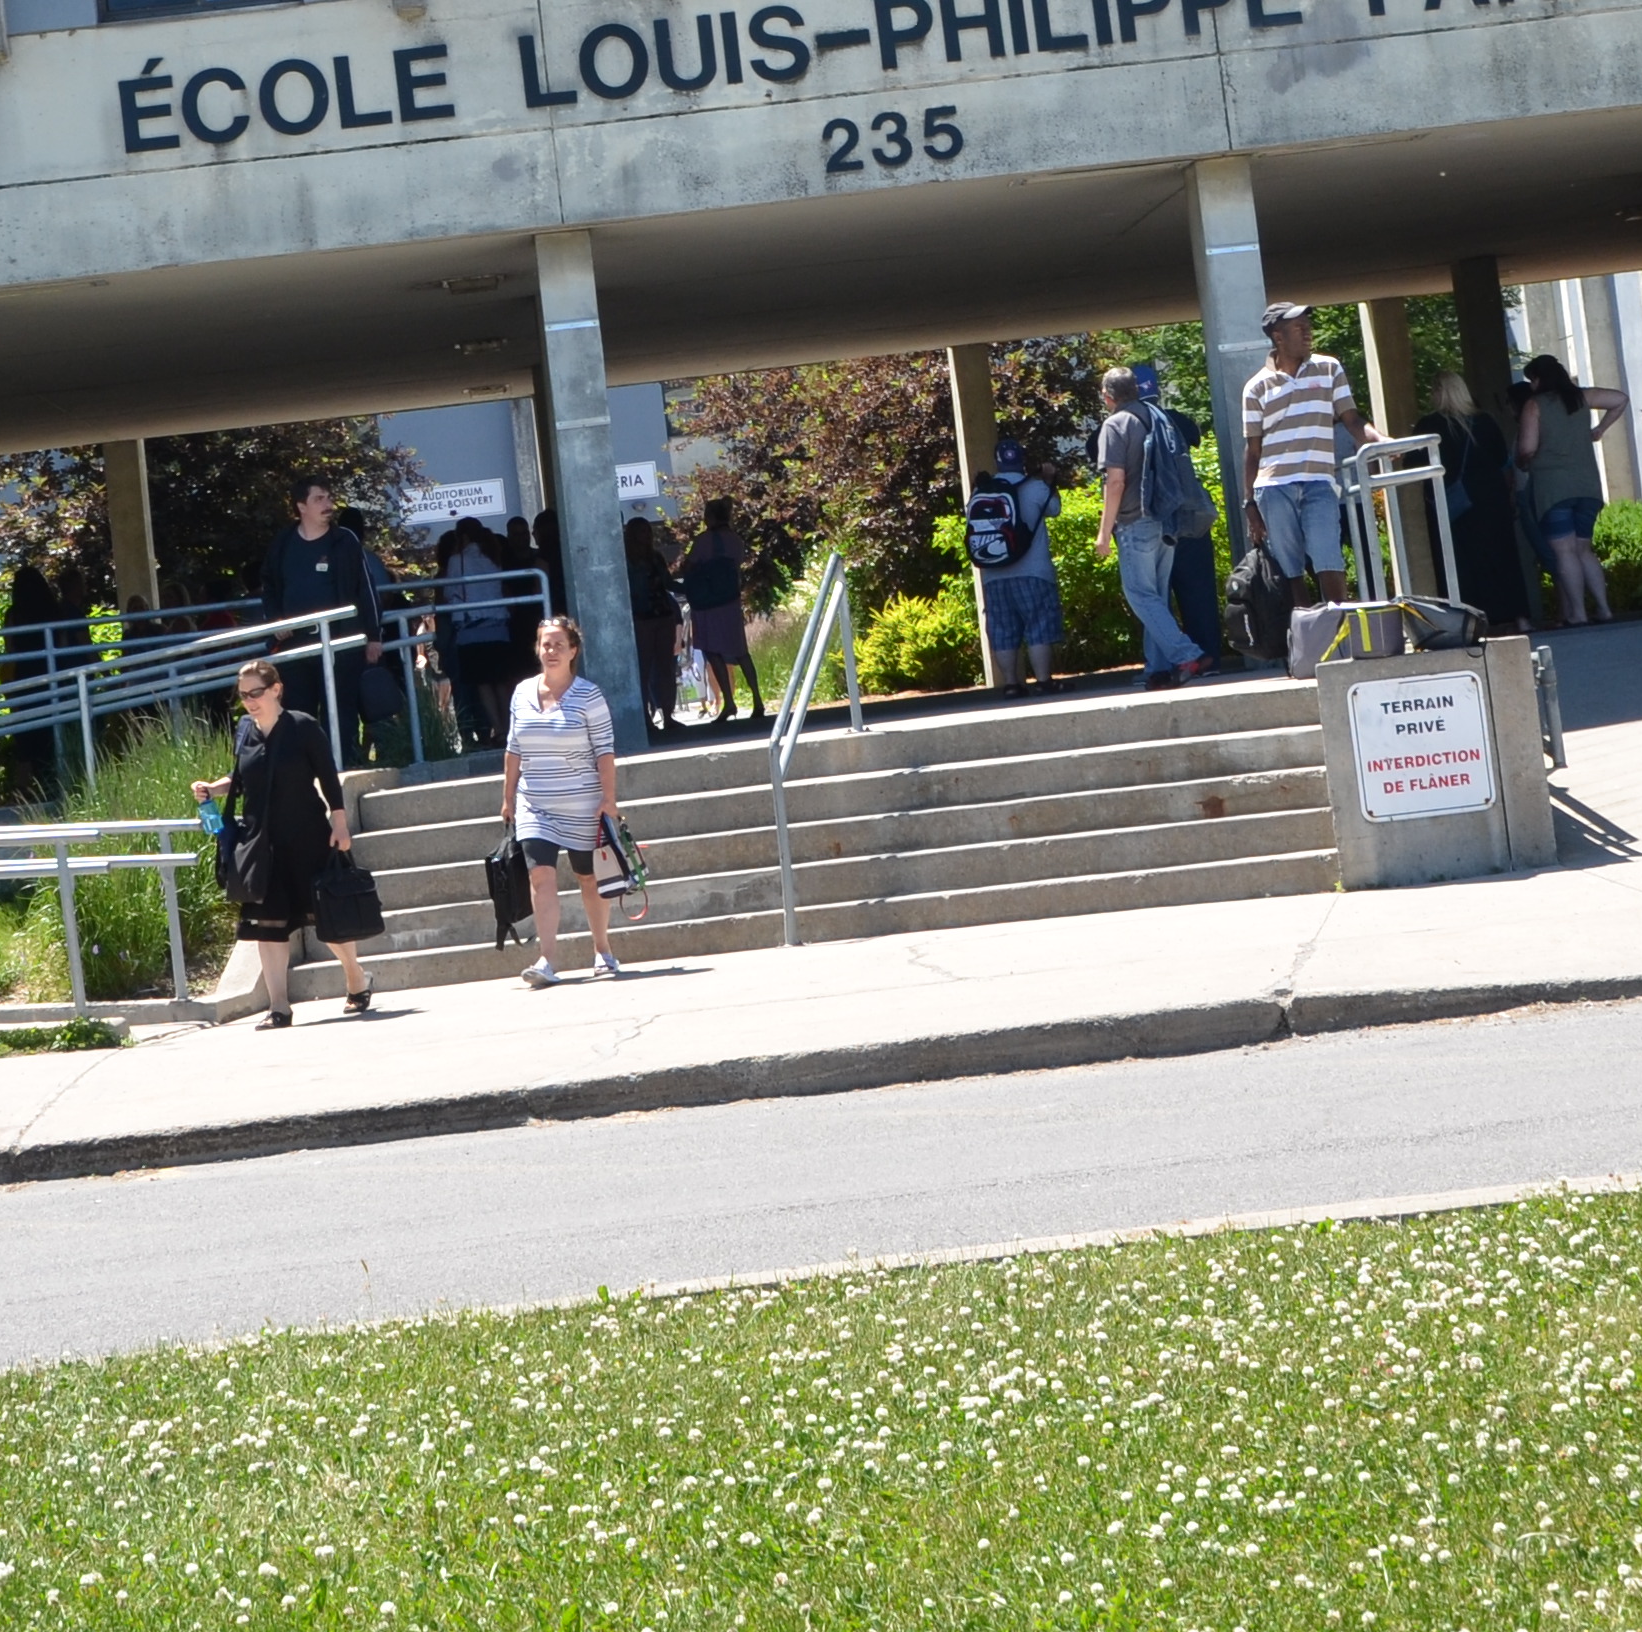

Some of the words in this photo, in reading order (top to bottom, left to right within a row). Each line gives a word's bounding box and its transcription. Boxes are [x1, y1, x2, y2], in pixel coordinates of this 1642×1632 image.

[117, 43, 456, 154] ÉCOLE
[821, 105, 964, 179] 235
[412, 495, 493, 512] SERGE-BOISVERT
[421, 487, 482, 501] AUDITORIUM
[1380, 695, 1454, 714] TERRAIN
[1395, 716, 1446, 735] PRIVÉ
[1367, 749, 1480, 773] INTERDICTION
[1383, 780, 1405, 794] DE
[1410, 773, 1470, 791] FLÂNER
